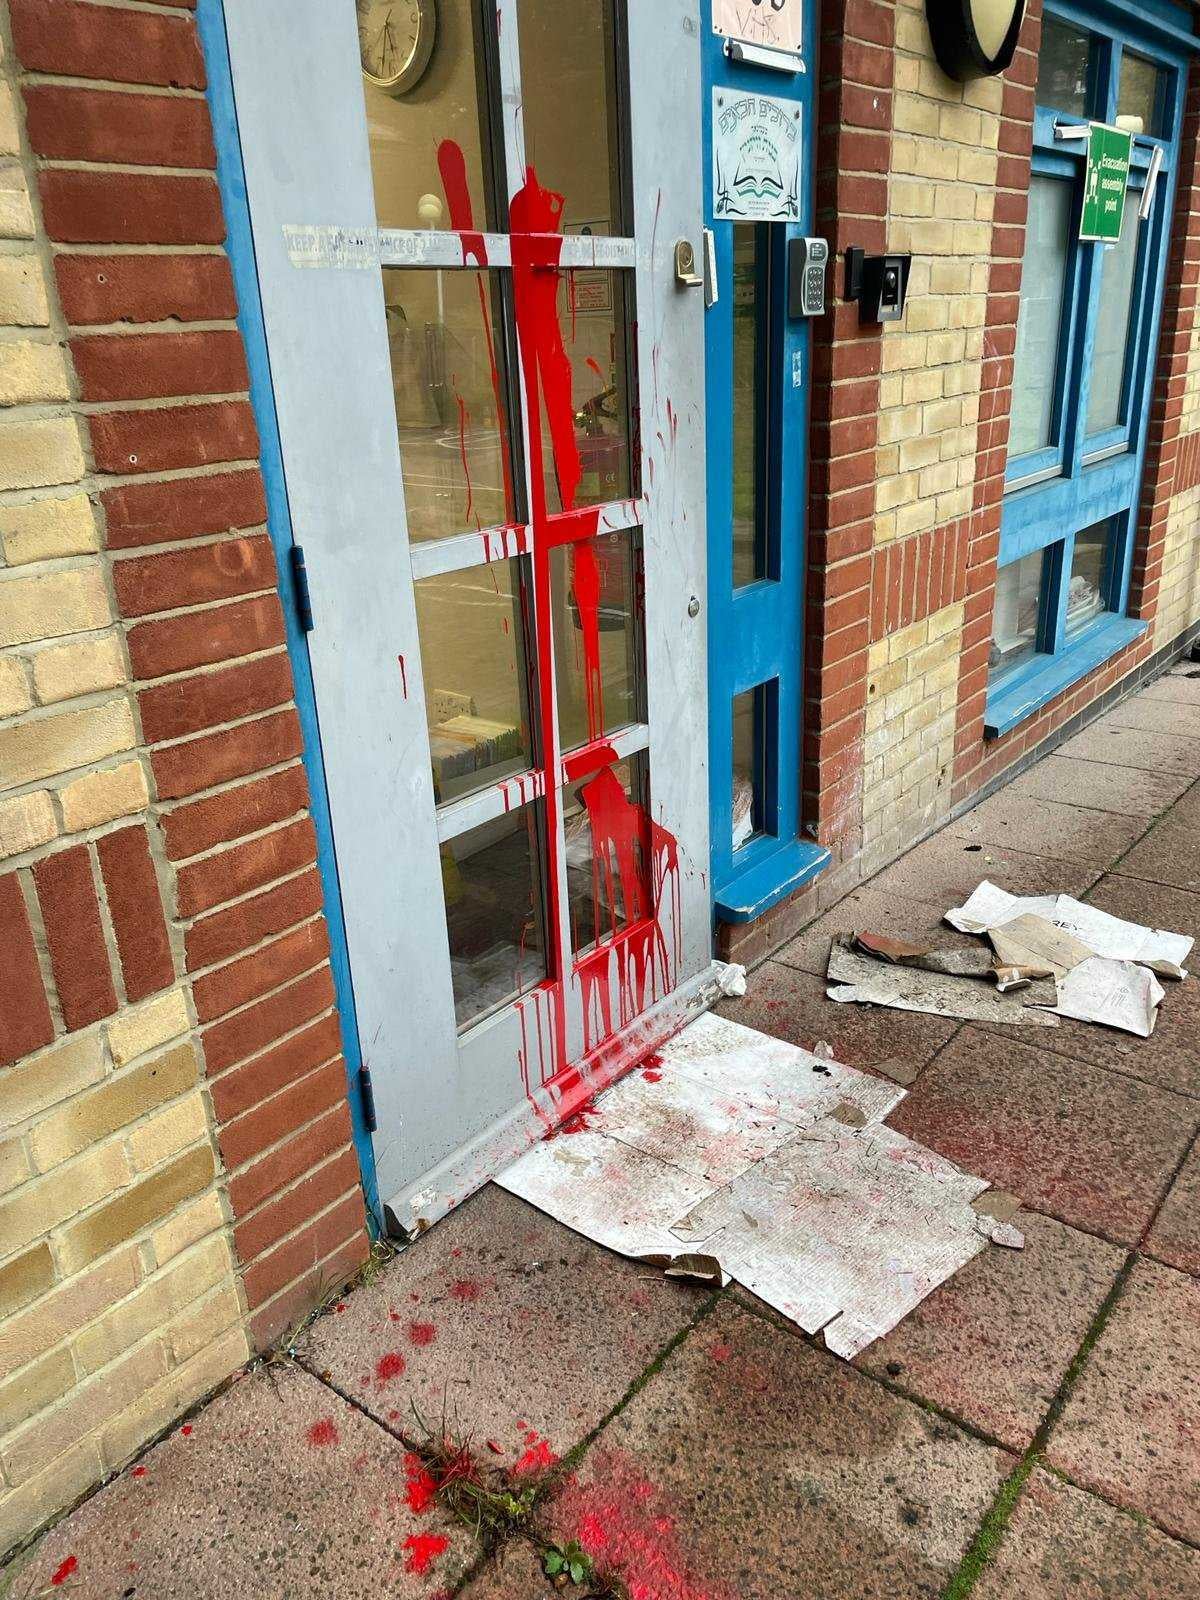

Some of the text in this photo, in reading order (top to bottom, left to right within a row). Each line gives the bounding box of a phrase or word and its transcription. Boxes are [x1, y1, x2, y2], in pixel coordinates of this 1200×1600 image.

[1102, 153, 1128, 172] Evacuation
[1101, 178, 1123, 196] assembly
[1104, 198, 1117, 213] point
